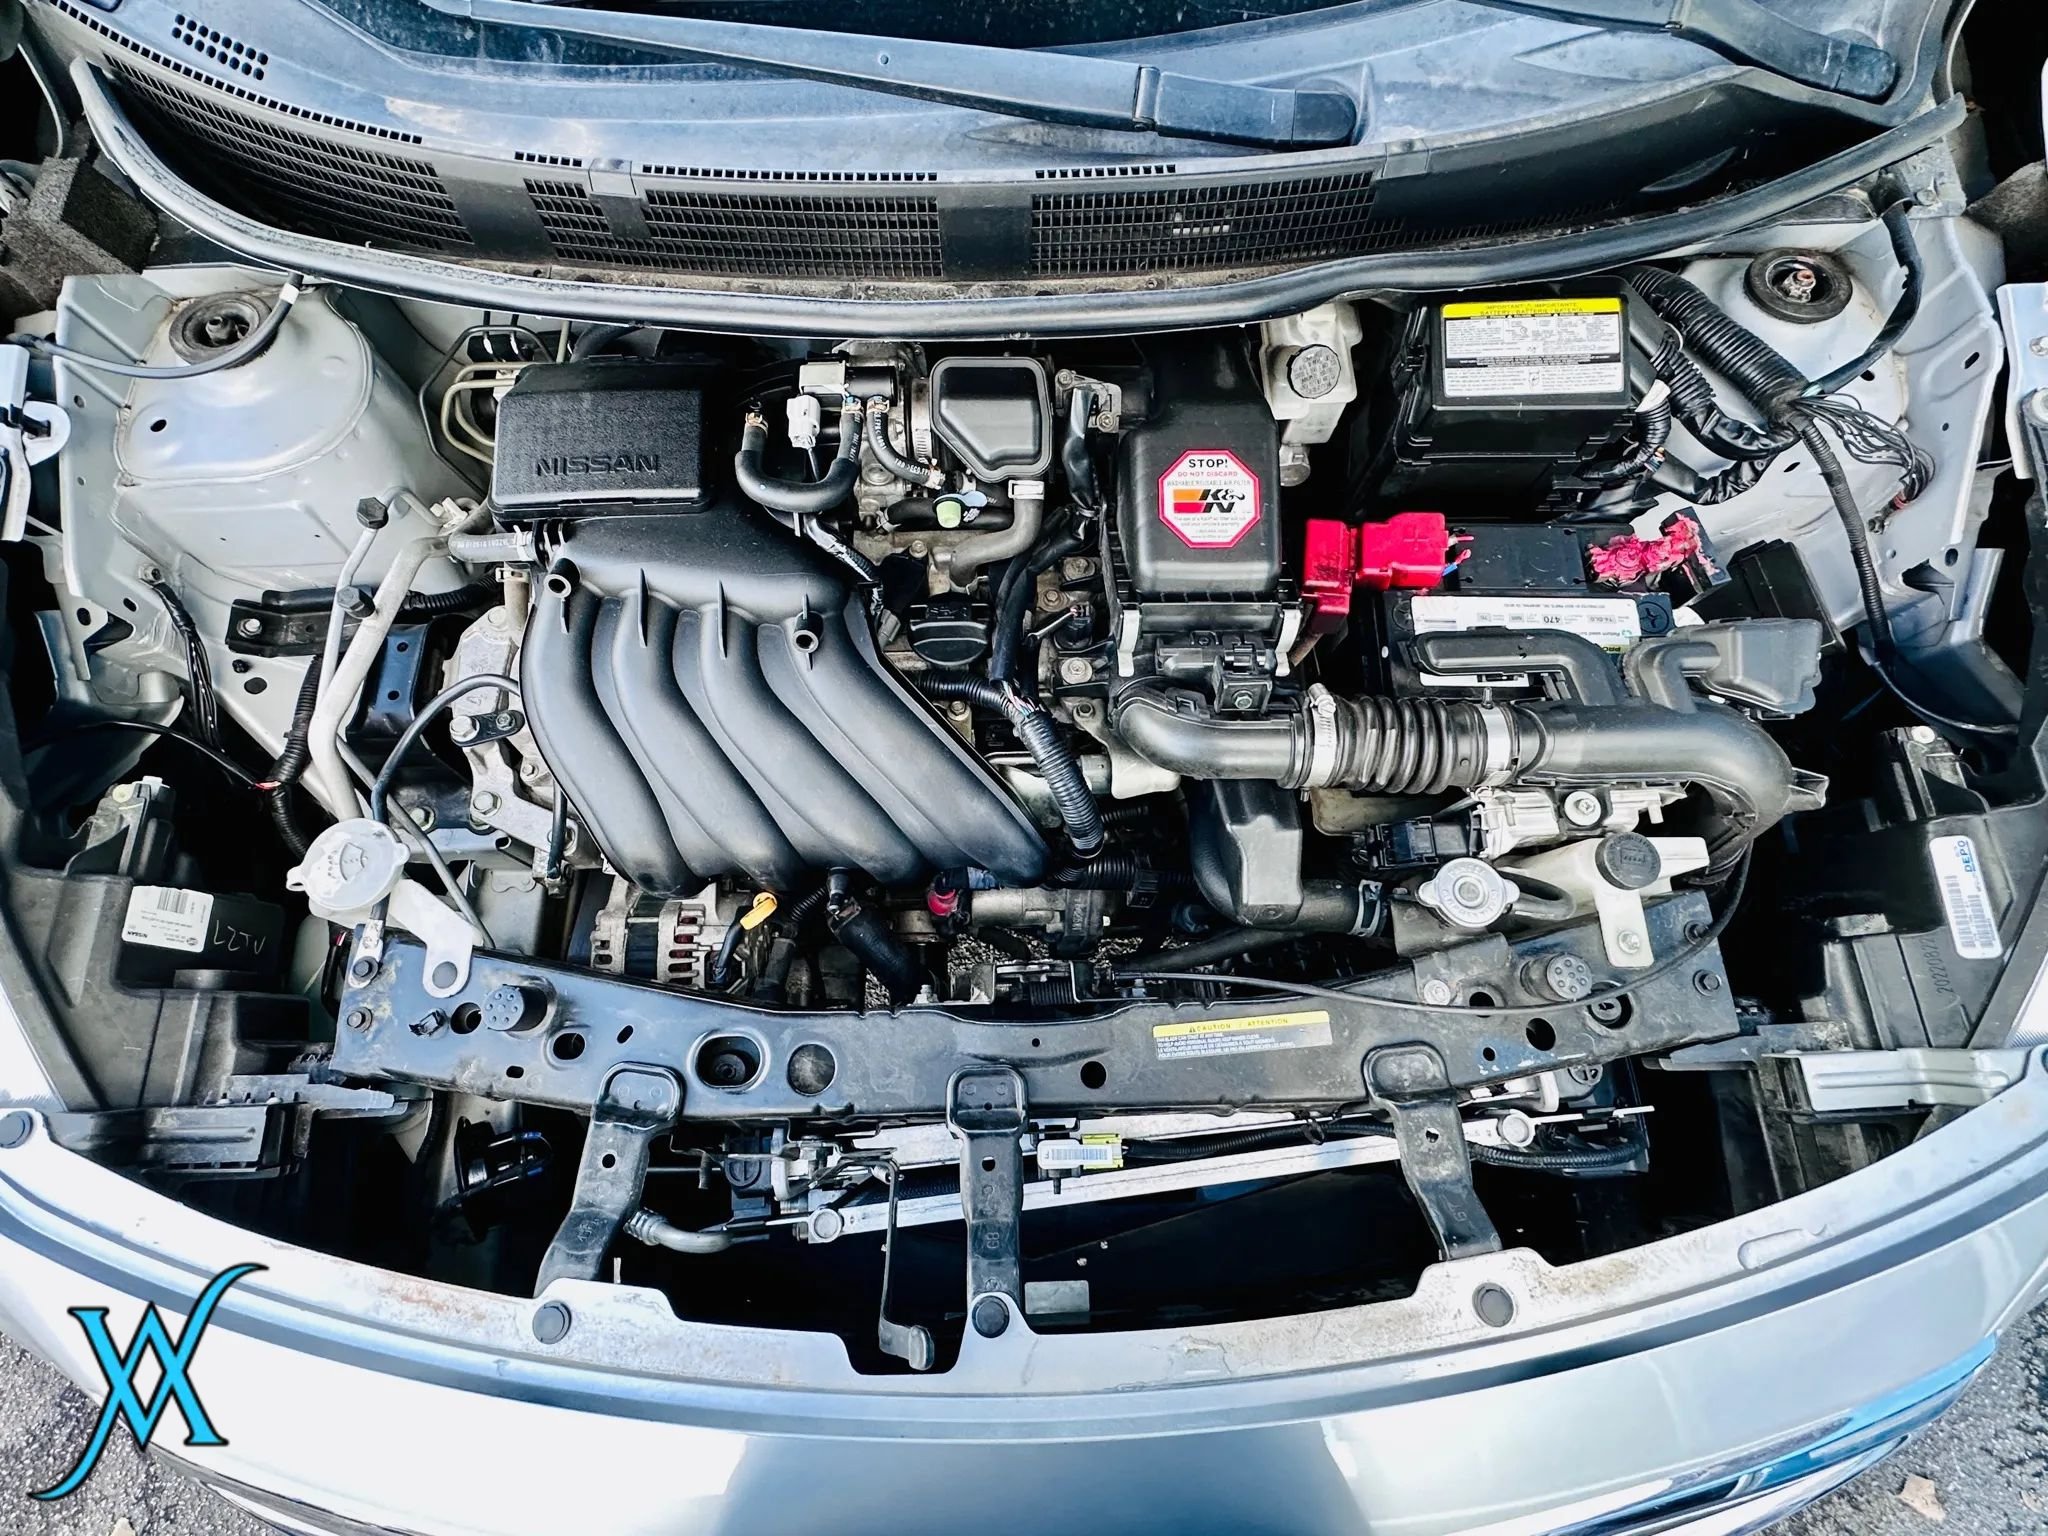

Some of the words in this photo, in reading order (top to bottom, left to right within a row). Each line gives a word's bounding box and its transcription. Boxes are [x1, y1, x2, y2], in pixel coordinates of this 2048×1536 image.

[535, 454, 659, 477] NISSAN
[1188, 458, 1228, 468] STOP!
[1543, 616, 1561, 624] 470
[1957, 840, 1974, 873] DEPO
[1195, 1023, 1231, 1032] CAUTION
[1247, 1018, 1288, 1027] ATTENTION
